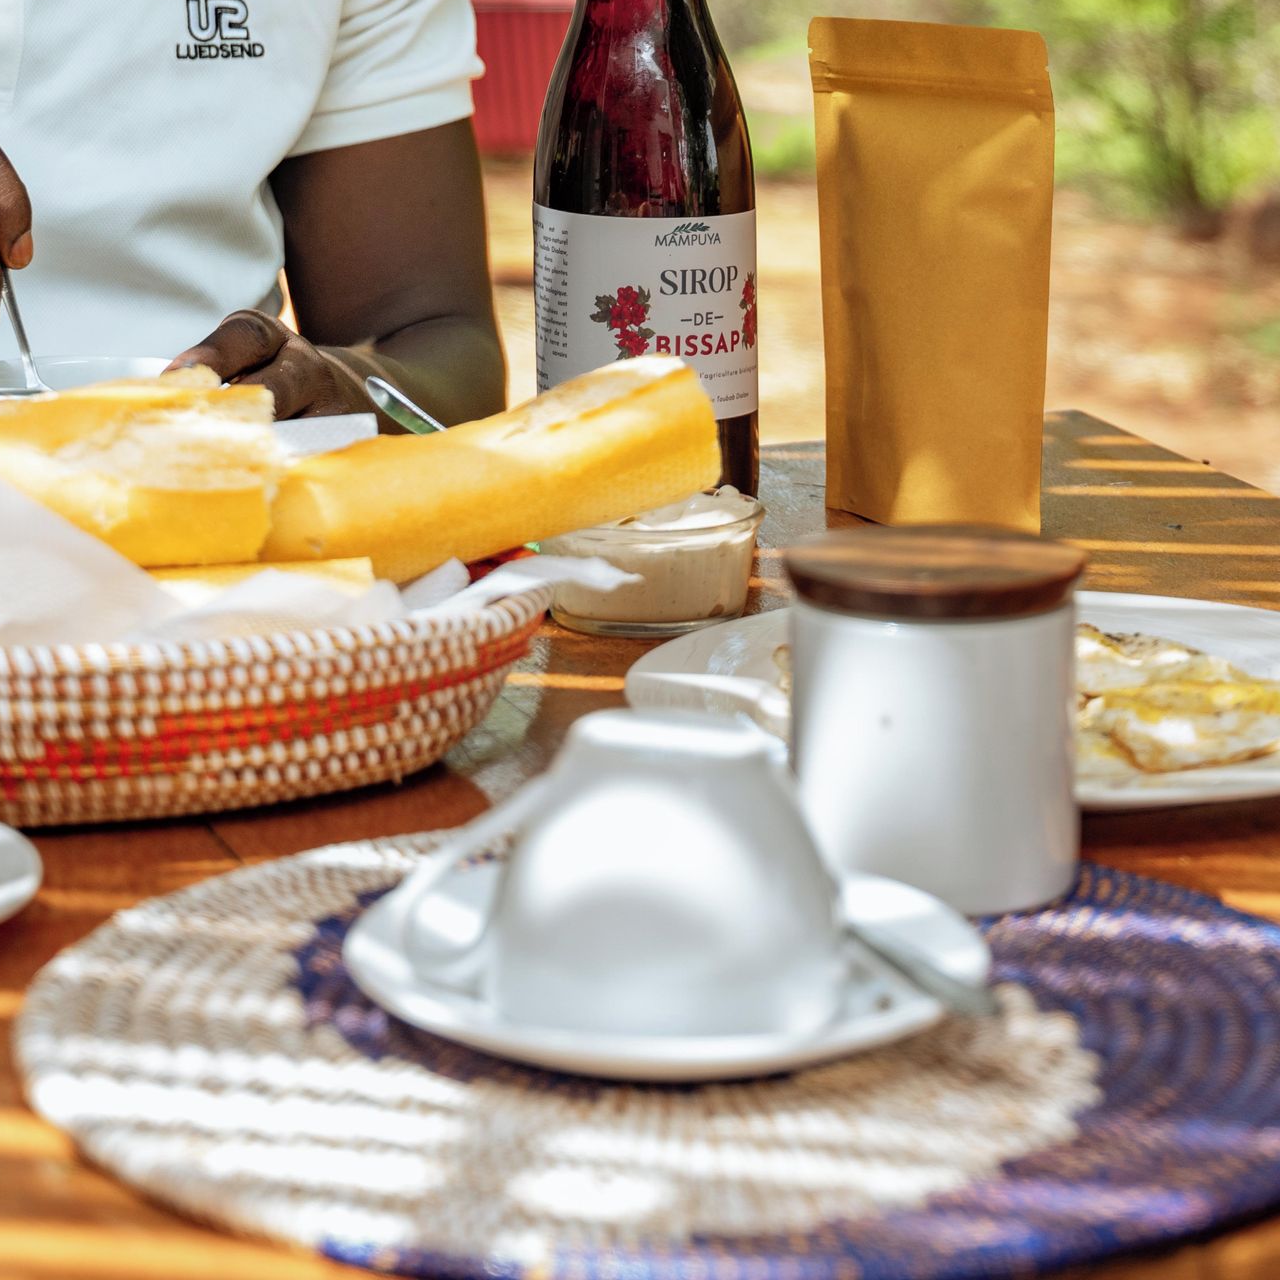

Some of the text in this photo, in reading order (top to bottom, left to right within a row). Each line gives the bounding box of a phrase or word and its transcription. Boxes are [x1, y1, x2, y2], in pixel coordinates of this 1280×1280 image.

[176, 43, 265, 60] LUEDSEND
[655, 233, 722, 247] MAMPUYA
[660, 265, 738, 295] SIROP
[656, 329, 740, 357] BISSAP
